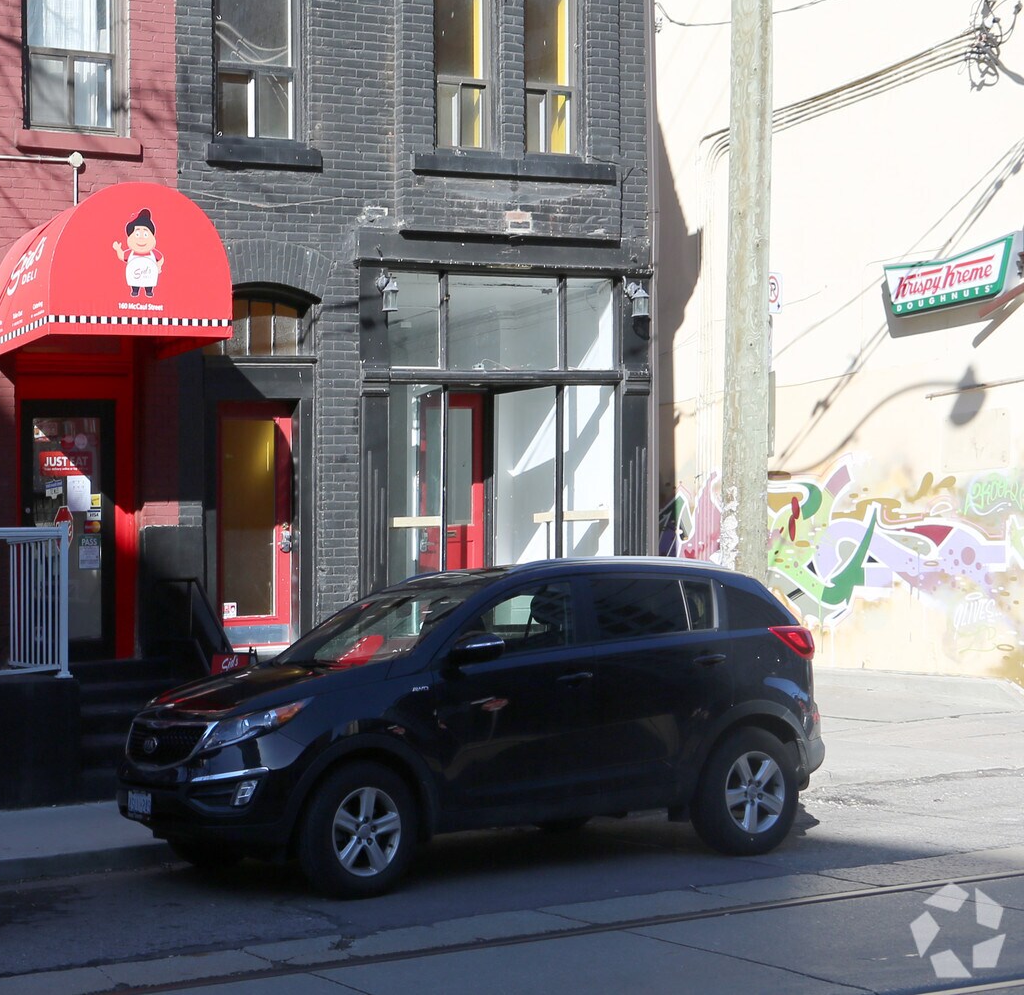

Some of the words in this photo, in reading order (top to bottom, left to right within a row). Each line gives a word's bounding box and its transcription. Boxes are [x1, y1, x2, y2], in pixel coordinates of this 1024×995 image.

[6, 236, 47, 296] Sid's
[21, 268, 38, 285] DELI
[895, 267, 943, 299] Krispy
[942, 254, 995, 289] Kreme
[128, 302, 148, 310] McCaul
[148, 303, 164, 311] Street
[896, 285, 992, 312] DOUGHNUTS
[43, 456, 68, 467] JUST
[69, 456, 88, 467] EAT
[81, 538, 97, 546] PASS
